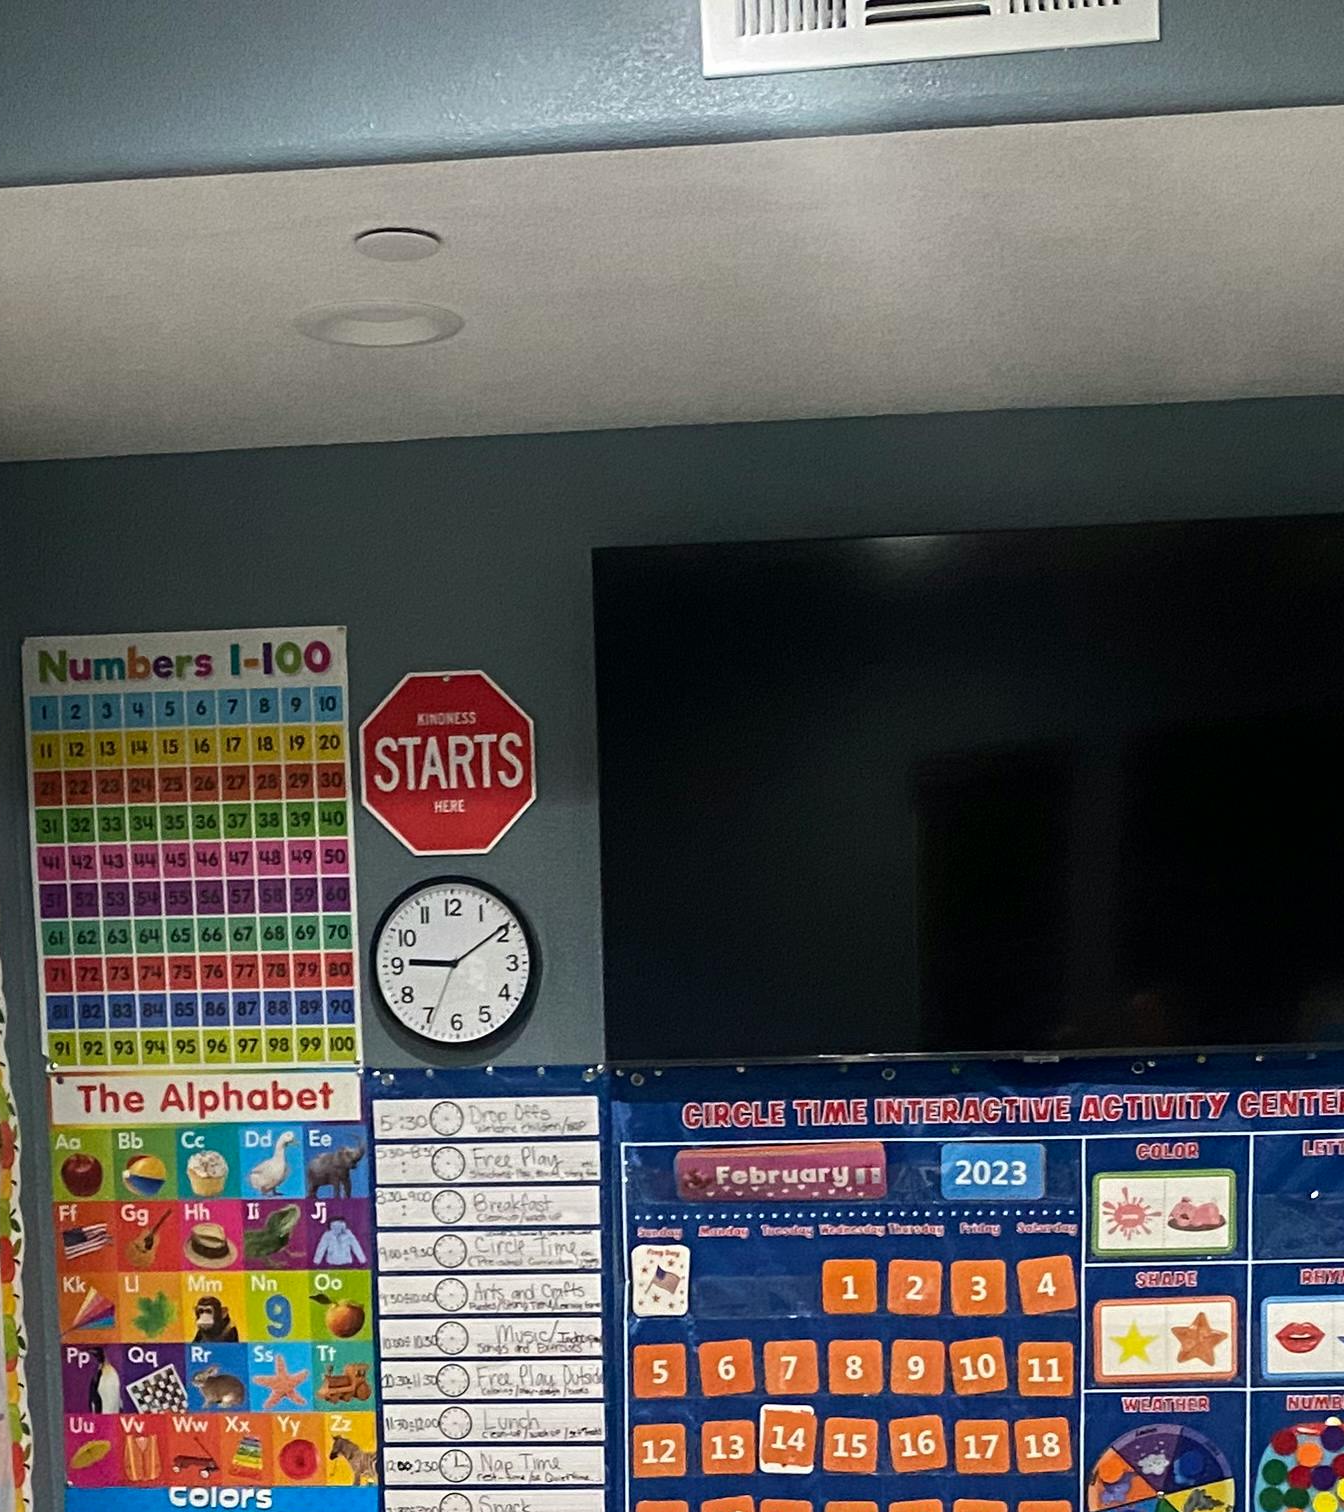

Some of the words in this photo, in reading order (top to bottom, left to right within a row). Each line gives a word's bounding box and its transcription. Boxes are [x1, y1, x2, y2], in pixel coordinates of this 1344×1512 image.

[38, 646, 213, 684] Numbers
[229, 640, 332, 677] 1-100
[417, 711, 476, 726] KINDNESS
[373, 732, 525, 794] STARTS
[434, 799, 466, 814] HERE
[420, 907, 430, 924] 11
[444, 899, 462, 918] 12
[478, 905, 484, 922] 1
[398, 930, 417, 947] 10
[392, 958, 404, 975] 9
[506, 955, 519, 973] 3
[401, 986, 414, 1003] 8
[498, 985, 512, 1001] 4
[451, 1014, 463, 1031] 6
[479, 1006, 491, 1023] 5
[78, 1084, 145, 1114] The
[160, 1082, 334, 1118] Alphabet
[682, 1100, 787, 1129] CIRCLE
[793, 1100, 868, 1126] TIME
[874, 1097, 1071, 1124] INTERACTIVE
[1080, 1091, 1230, 1122] ACTIVITY
[55, 1136, 82, 1151] Aa
[118, 1133, 143, 1149] Bb
[181, 1133, 206, 1149] Cc
[245, 1132, 272, 1148] Dd
[309, 1131, 332, 1147] Ee
[473, 1147, 512, 1168] Free
[521, 1146, 563, 1169] Play
[1136, 1142, 1199, 1160] COLOR
[716, 1165, 850, 1187] February
[954, 1160, 1027, 1186] 2023
[473, 1193, 553, 1212] Breakfast
[59, 1206, 77, 1222] Ff
[122, 1206, 148, 1226] Gg
[185, 1205, 210, 1221] Hh
[247, 1205, 260, 1219] Ii
[311, 1205, 328, 1223] Jj
[637, 1227, 683, 1240] Sunday
[698, 1226, 749, 1240] Monday
[760, 1225, 813, 1238] Tuesday
[819, 1224, 885, 1237] Wednesday
[889, 1223, 944, 1237] Thursday
[960, 1223, 1001, 1237] Friday
[1016, 1222, 1076, 1236] Saturday
[474, 1237, 525, 1254] Circle
[63, 1276, 85, 1293] Kk
[125, 1277, 139, 1292] Ll
[188, 1278, 223, 1292] Mm
[251, 1277, 278, 1291] Nn
[314, 1276, 342, 1291] Oo
[843, 1276, 858, 1299] 1
[906, 1276, 923, 1300] 2
[971, 1276, 987, 1300] 3
[1038, 1273, 1056, 1296] 4
[1135, 1271, 1198, 1288] SHAPE
[473, 1282, 504, 1300] Arts
[511, 1283, 534, 1300] and
[541, 1282, 585, 1298] Crafts
[67, 1348, 90, 1368] Pp
[128, 1347, 158, 1368] Qq
[191, 1347, 211, 1362] Rr
[254, 1347, 274, 1362] Ss
[317, 1346, 336, 1362] Tt
[476, 1367, 512, 1386] Free
[520, 1364, 555, 1385] Play
[653, 1360, 668, 1383] 5
[718, 1356, 735, 1380] 6
[781, 1356, 797, 1380] 7
[846, 1356, 863, 1379] 8
[908, 1356, 924, 1380] 9
[960, 1354, 995, 1380] 10
[1028, 1358, 1062, 1382] 11
[1121, 1396, 1209, 1413] WEATHER
[70, 1418, 95, 1434] Uu
[121, 1418, 145, 1433] Vv
[173, 1418, 209, 1433] Ww
[225, 1418, 250, 1433] Xx
[277, 1417, 300, 1436] Yy
[331, 1417, 352, 1433] Zz
[483, 1410, 539, 1430] Lunch
[643, 1439, 675, 1463] 12
[712, 1435, 744, 1459] 13
[771, 1426, 805, 1451] 14
[833, 1434, 867, 1458] 15
[900, 1430, 935, 1456] 16
[964, 1435, 998, 1459] 17
[1025, 1433, 1060, 1458] 18
[480, 1453, 513, 1472] Nap
[519, 1453, 561, 1470] Time
[169, 1487, 273, 1509] Colors
